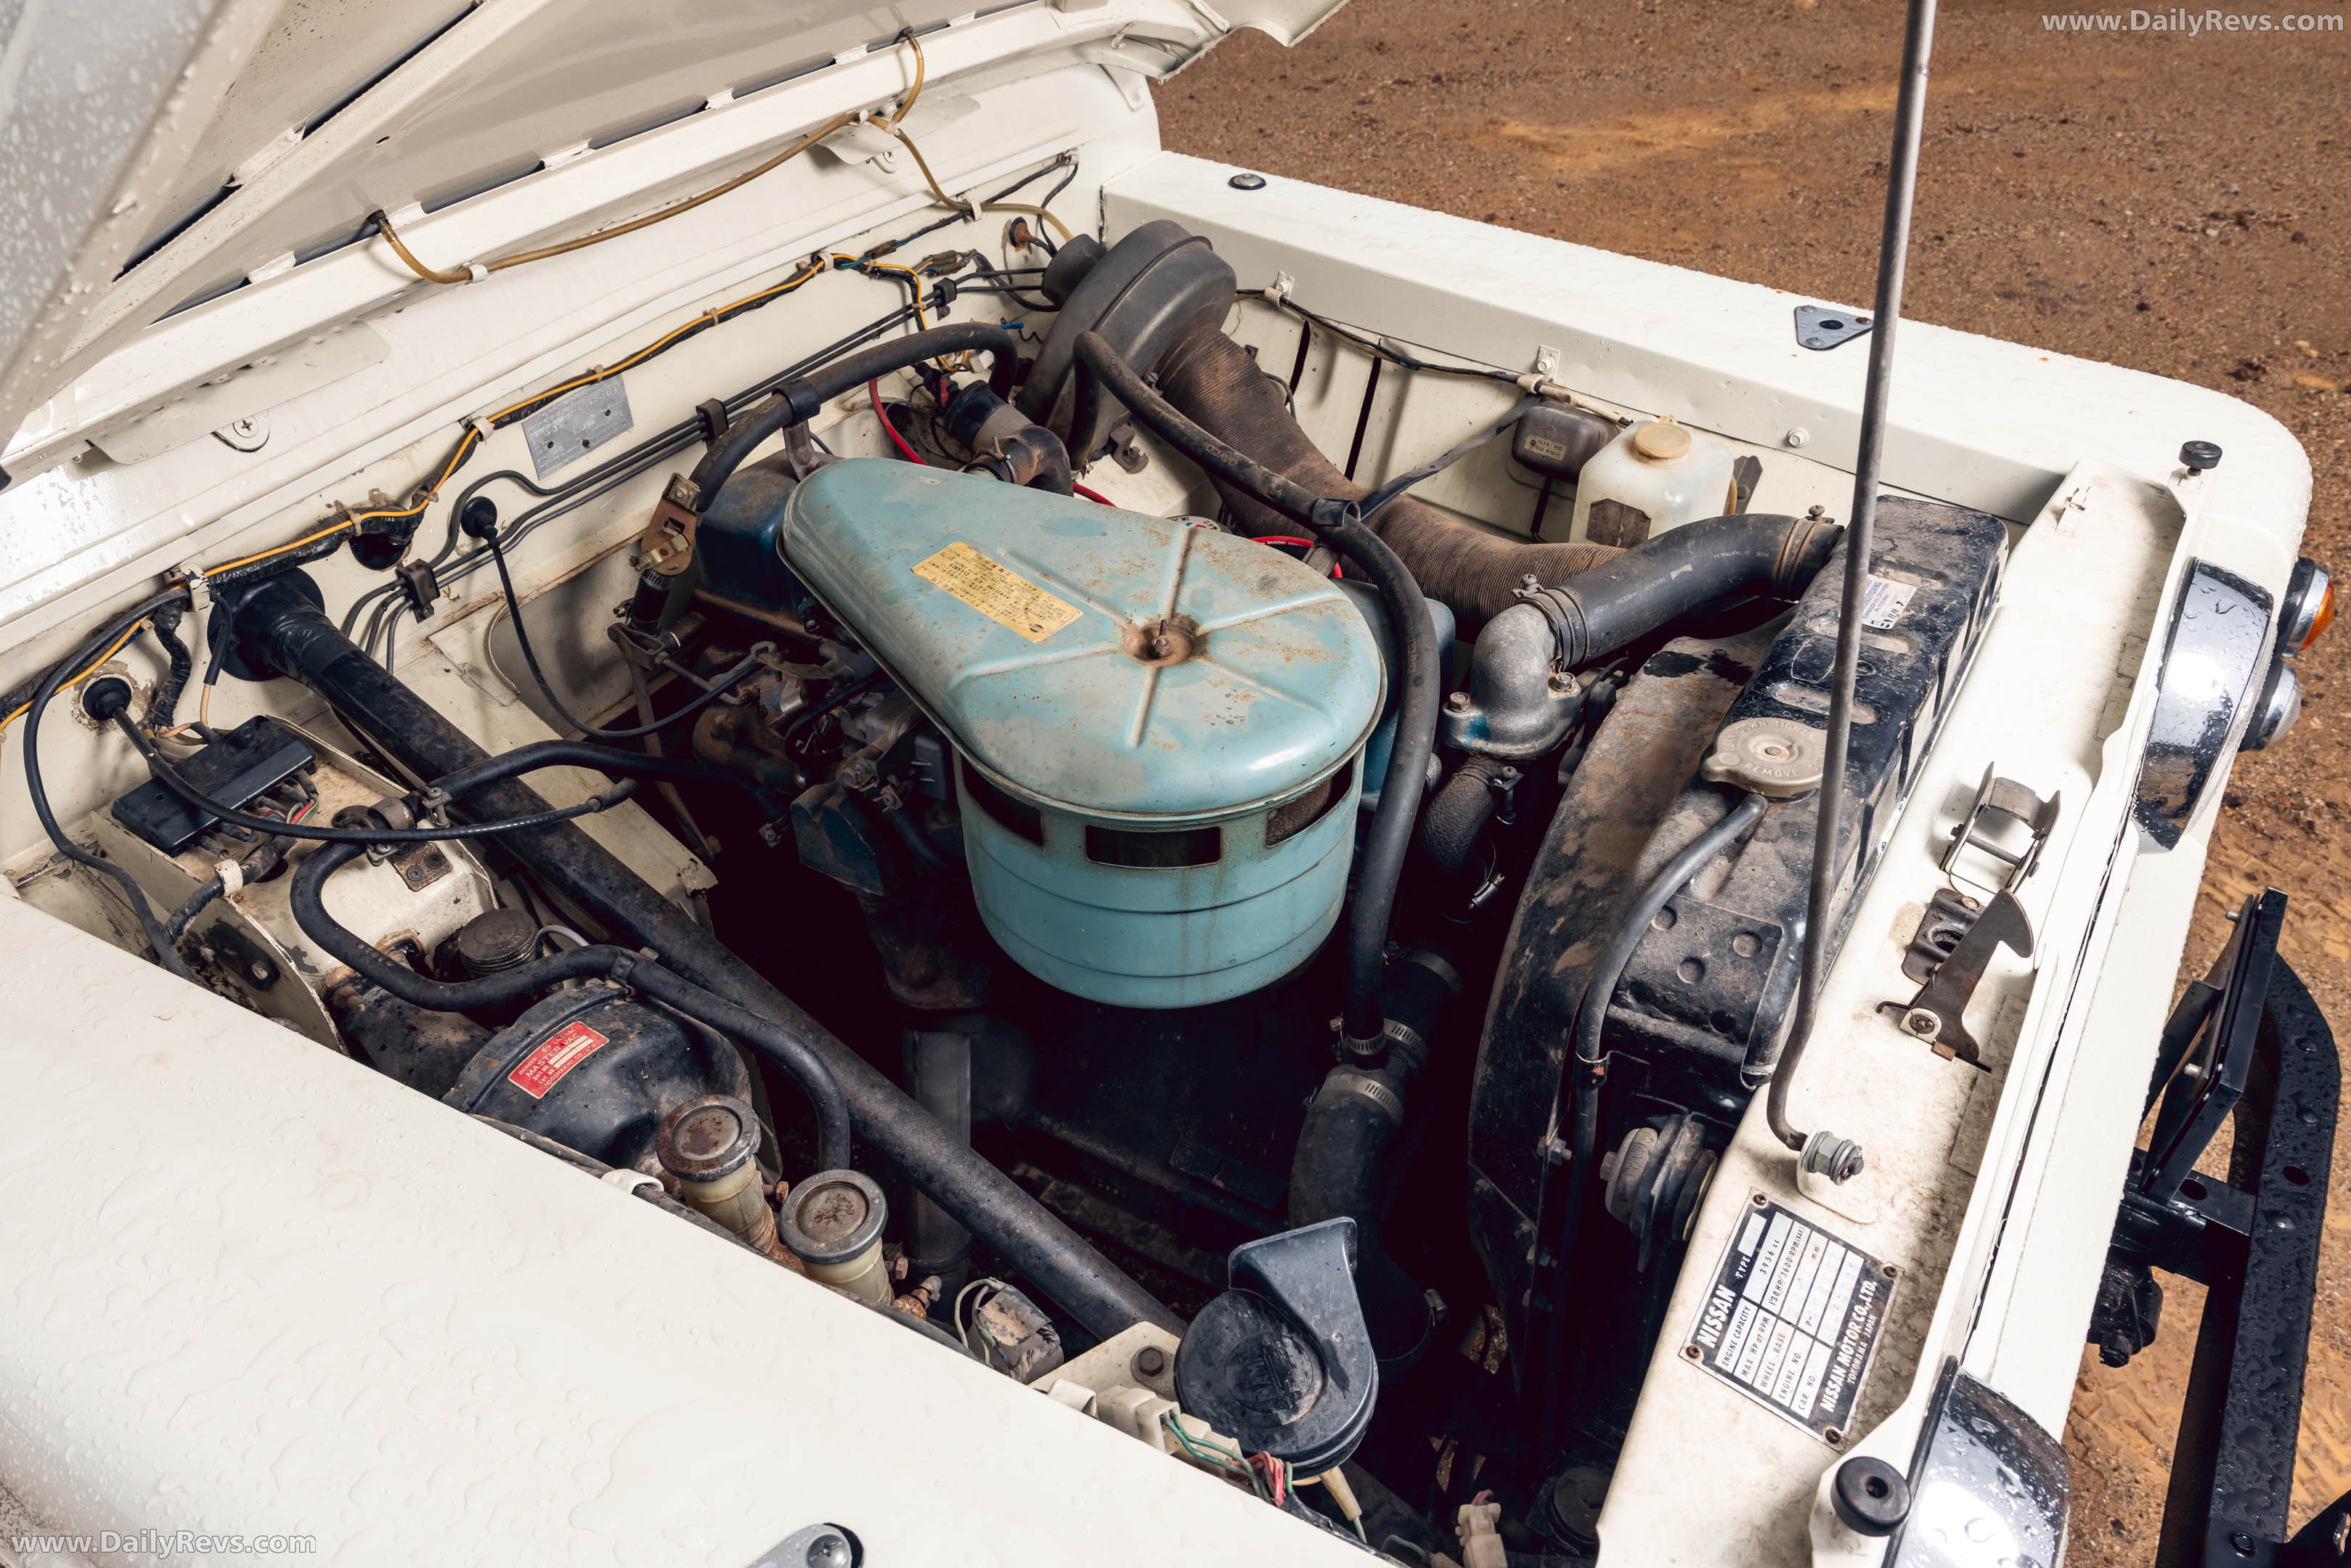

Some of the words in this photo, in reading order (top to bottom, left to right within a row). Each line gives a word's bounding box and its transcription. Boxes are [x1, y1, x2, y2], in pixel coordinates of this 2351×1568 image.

[947, 562, 971, 576] CLEANER
[985, 584, 1011, 600] HANDLING
[1023, 606, 1046, 620] CAUTION
[1744, 764, 1801, 777] REMOVE
[518, 1057, 538, 1075] BENDIX
[526, 1046, 562, 1078] MASTER
[563, 1033, 580, 1045] VAC
[544, 1060, 574, 1089] JIDOSHAKIKI
[532, 1071, 543, 1082] Unit
[538, 1076, 548, 1085] Lot
[1695, 1283, 1737, 1349] NISSAN
[1735, 1254, 1751, 1280] TYPE
[1721, 1339, 1738, 1367] ENGINE
[1732, 1304, 1752, 1340] CAPACITY
[1759, 1249, 1775, 1275] 3956
[1740, 1353, 1756, 1378] MAX.
[1749, 1341, 1760, 1355] HP
[1757, 1315, 1770, 1334] RPM
[1759, 1360, 1776, 1389] WHEEL
[1772, 1331, 1786, 1354] BASE
[1819, 1363, 1848, 1413] NISSAN
[1835, 1320, 1863, 1367] MOTOR
[1846, 1339, 1868, 1386] YOKOHAMA
[1862, 1313, 1878, 1338] JAPAN
[1777, 1368, 1795, 1400] ENGINE
[1790, 1349, 1802, 1365] NO.
[1797, 1392, 1809, 1411] CAR
[1806, 1371, 1817, 1388] NO.
